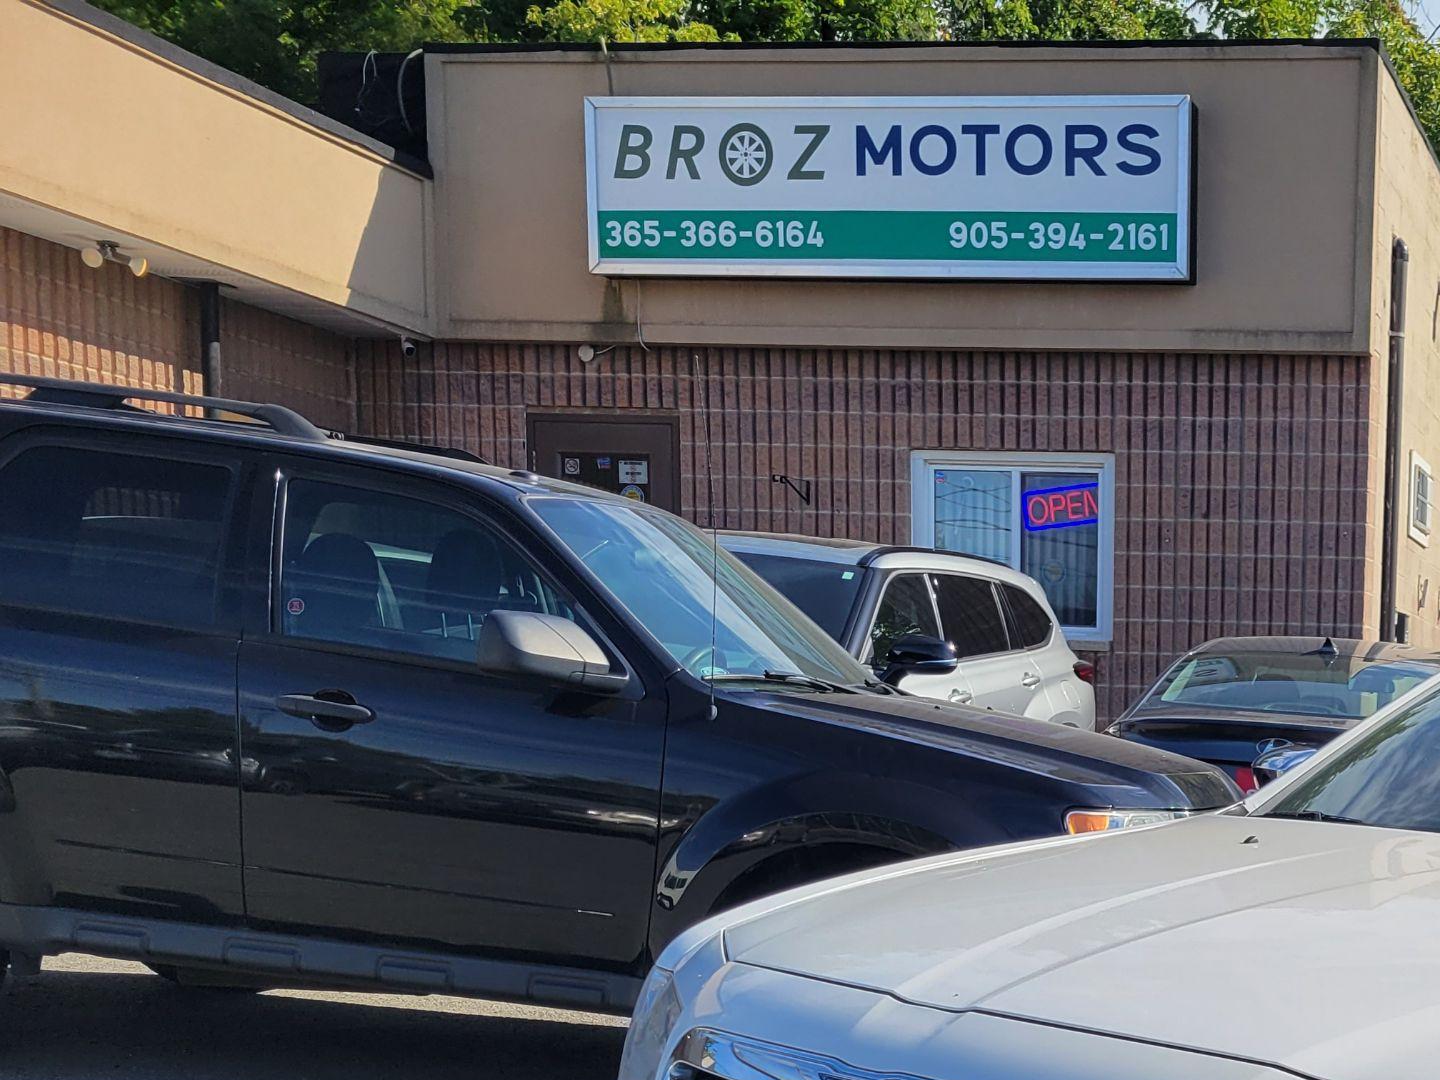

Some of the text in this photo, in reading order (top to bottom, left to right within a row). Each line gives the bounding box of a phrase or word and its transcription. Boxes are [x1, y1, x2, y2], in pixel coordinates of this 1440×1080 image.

[613, 123, 1162, 187] BROZ MOTORS
[605, 220, 825, 249] 365-366-6164
[949, 221, 1170, 252] 905-394-2161
[1027, 489, 1098, 525] OPEN
